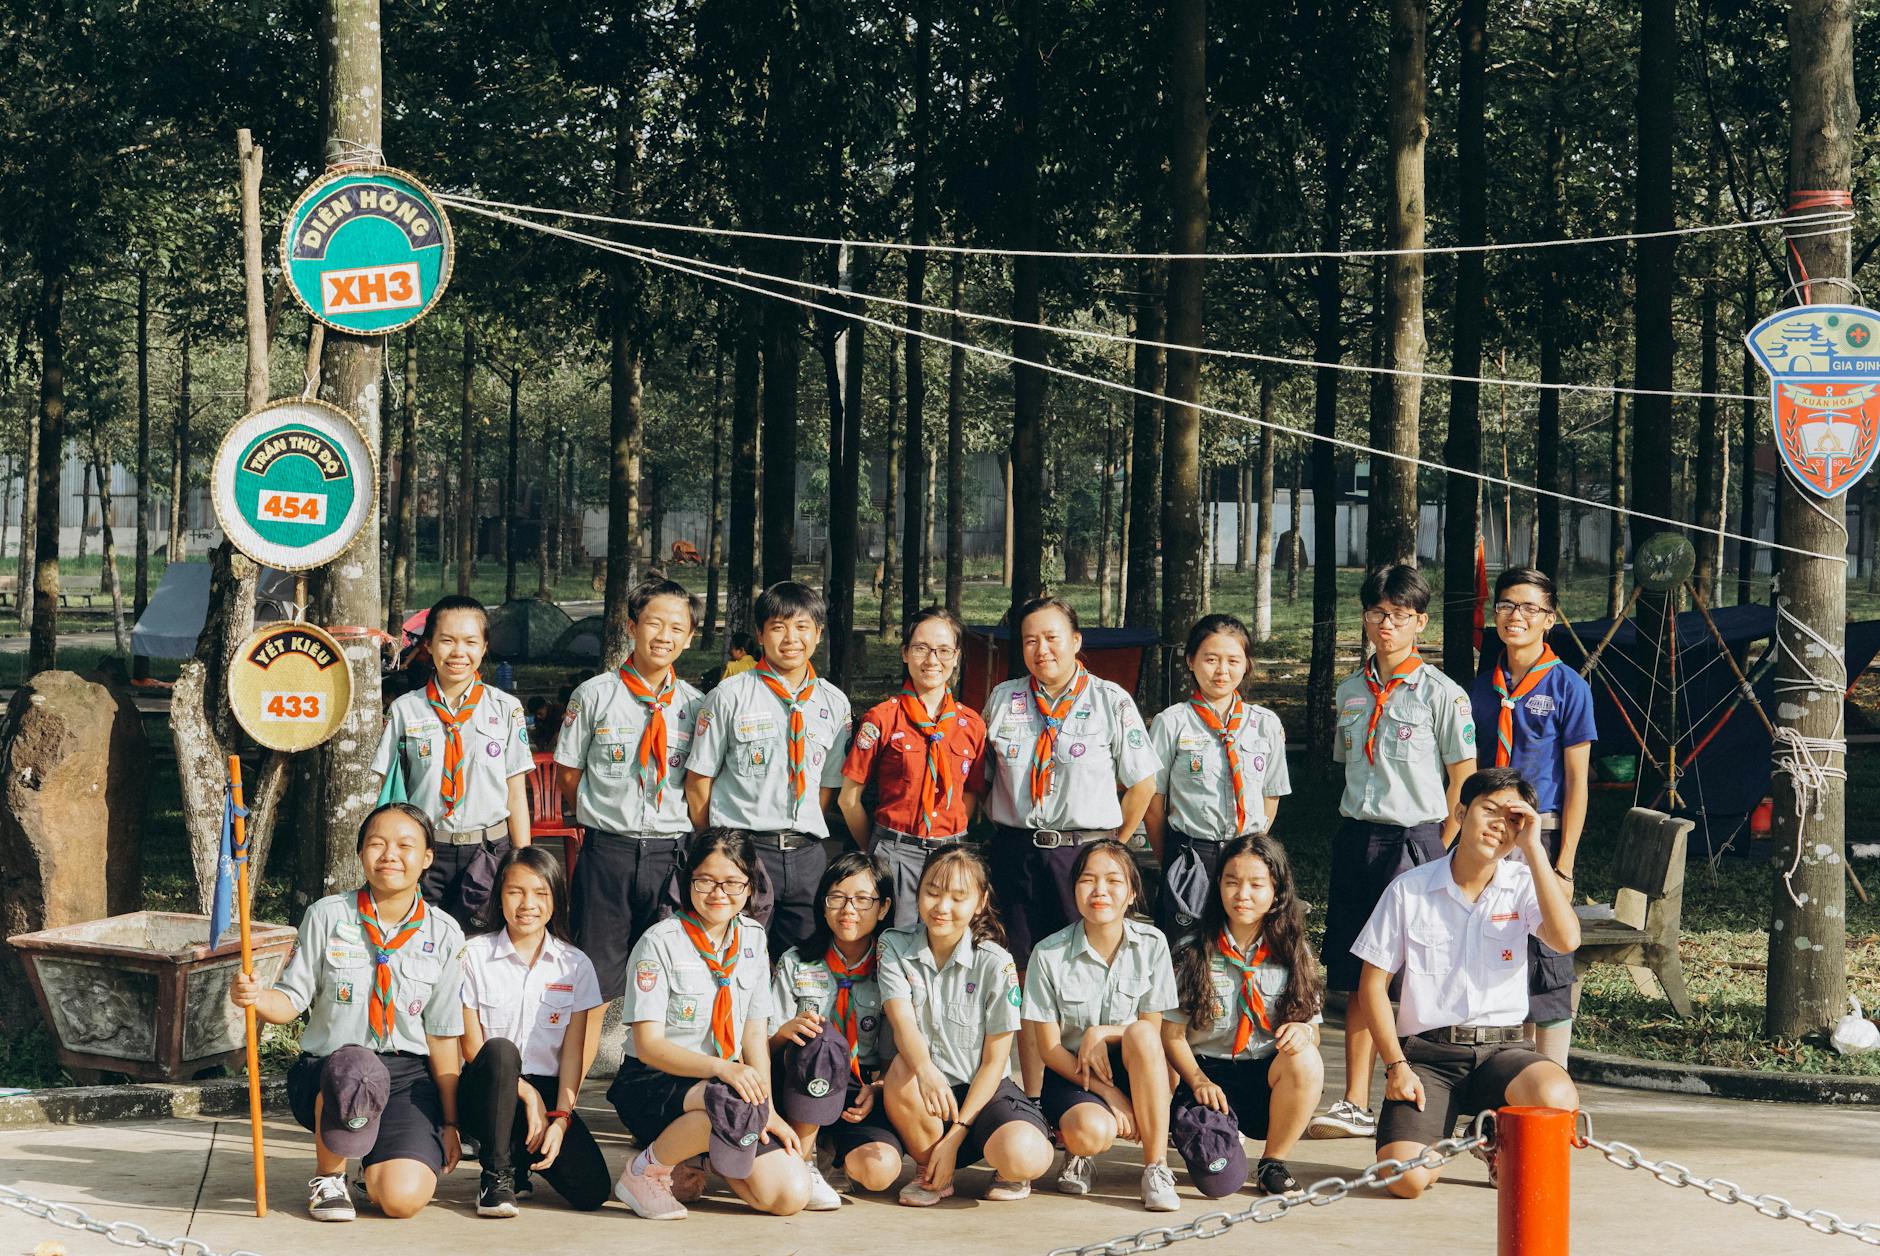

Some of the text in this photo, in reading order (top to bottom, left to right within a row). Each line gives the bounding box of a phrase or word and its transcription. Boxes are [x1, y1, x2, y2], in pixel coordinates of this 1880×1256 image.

[327, 271, 414, 307] XH3
[1832, 361, 1853, 370] GIA
[1815, 459, 1825, 467] 57
[263, 495, 320, 520] 454
[290, 636, 331, 665] KIÊU
[267, 695, 320, 718] 433
